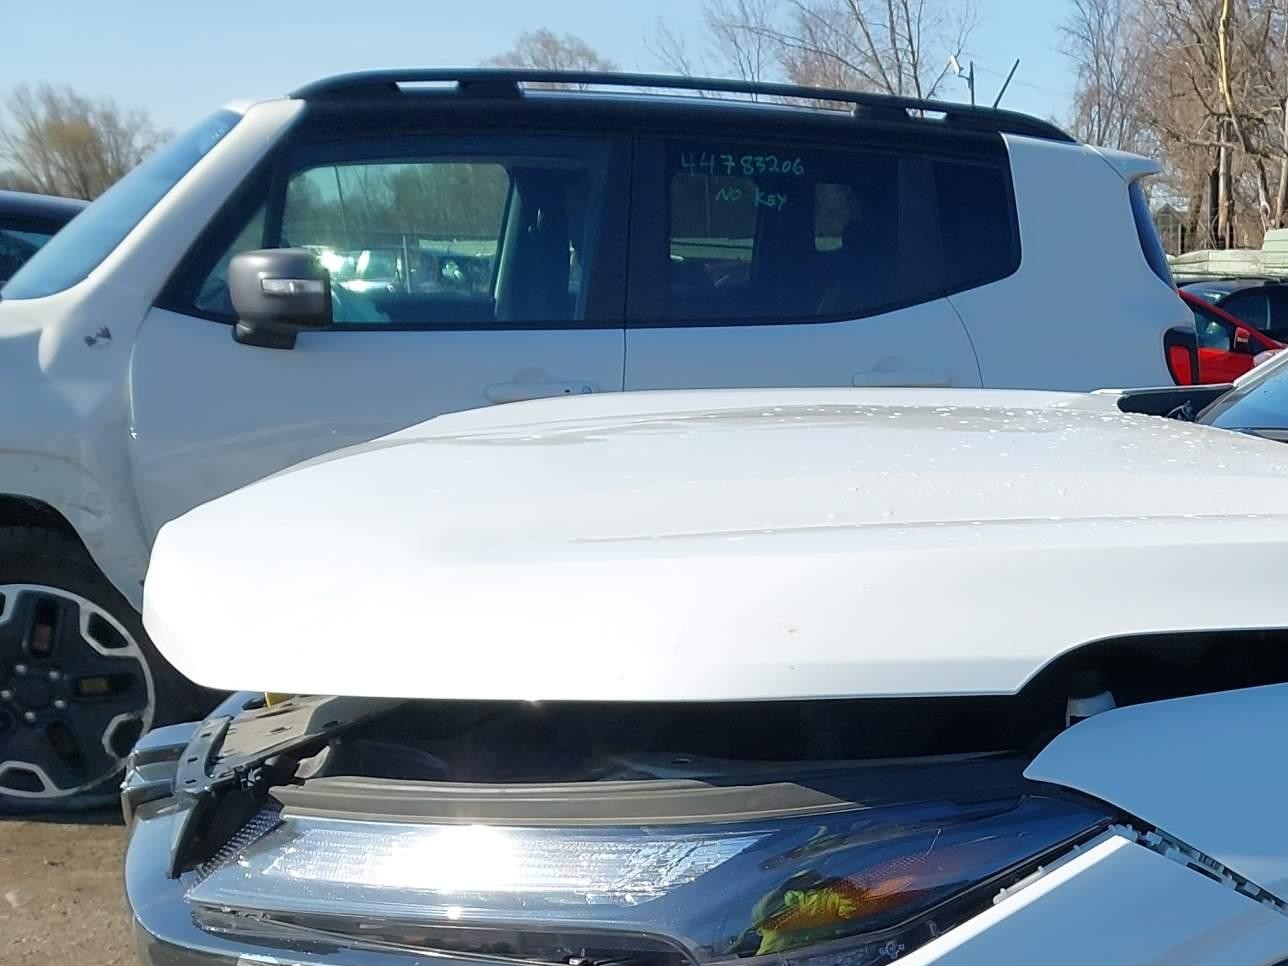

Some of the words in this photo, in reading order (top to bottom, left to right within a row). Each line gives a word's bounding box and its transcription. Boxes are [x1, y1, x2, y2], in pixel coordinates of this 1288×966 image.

[681, 152, 805, 176] 44783206
[715, 187, 742, 201] NO
[754, 187, 788, 211] KEY
